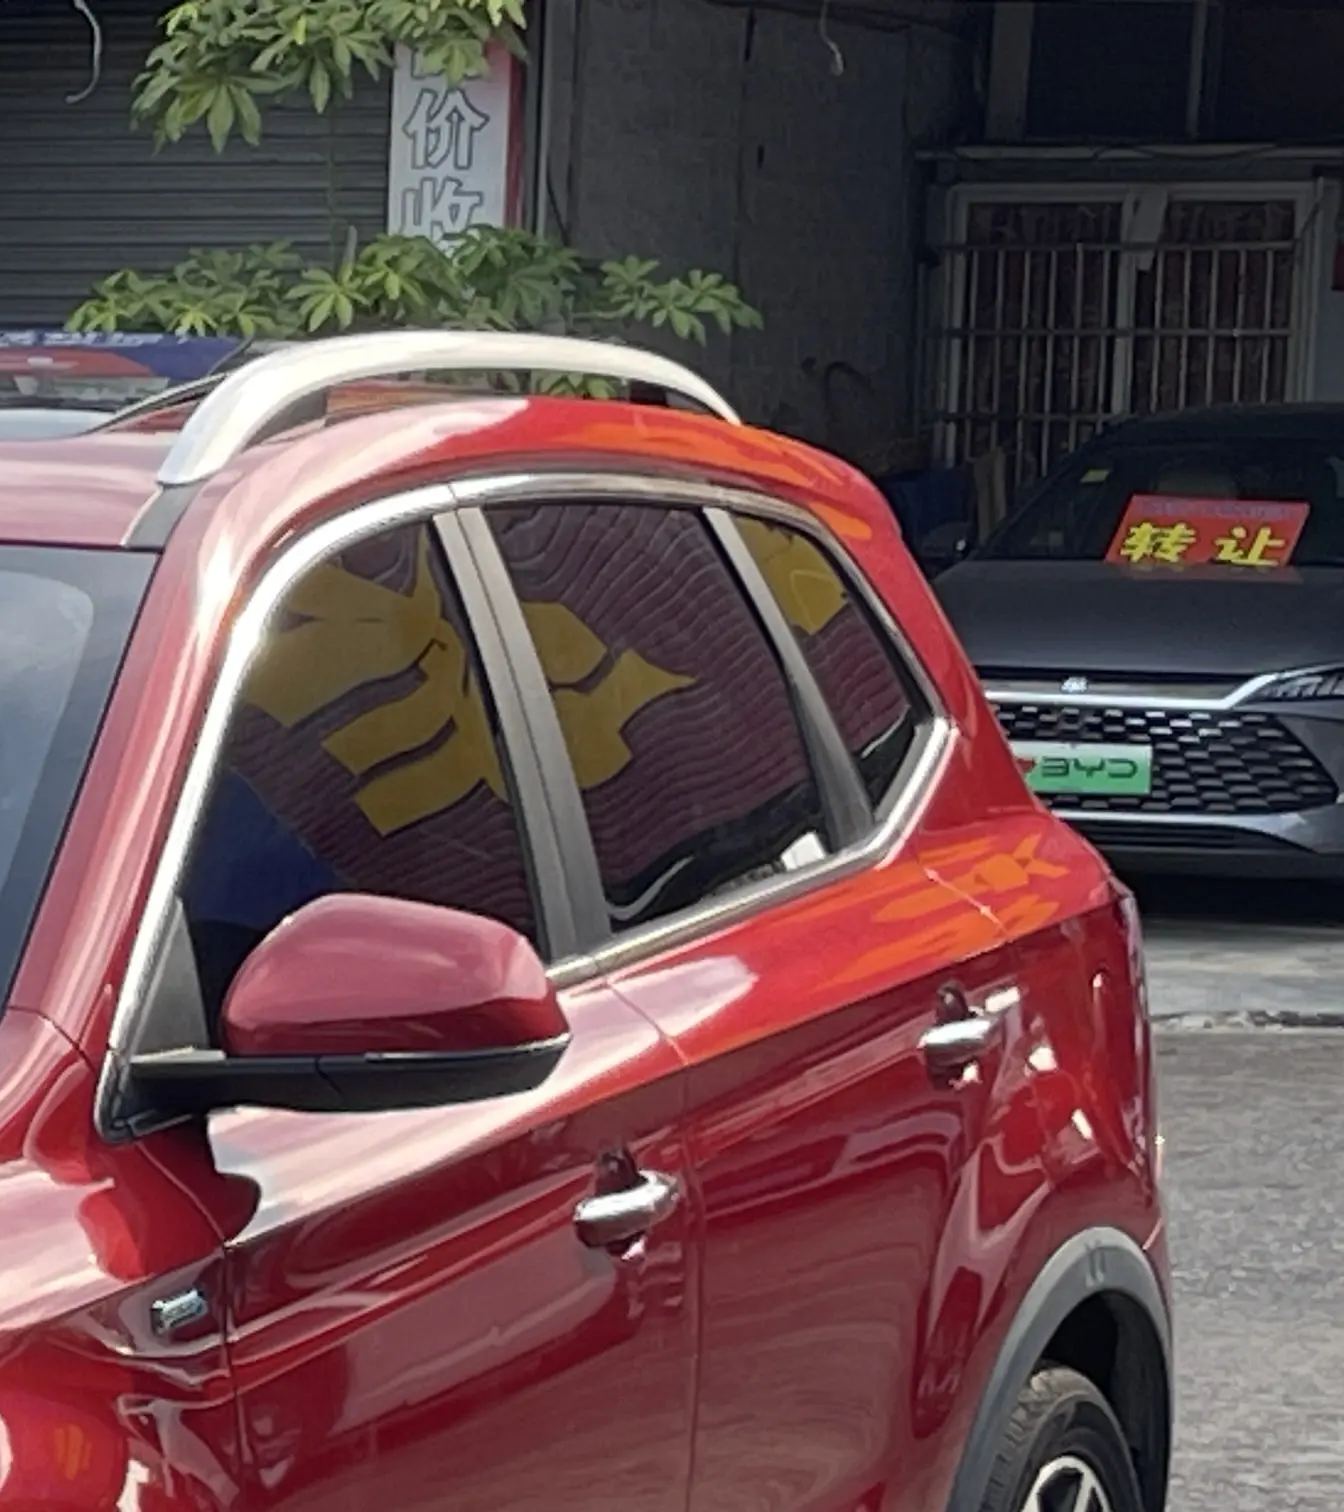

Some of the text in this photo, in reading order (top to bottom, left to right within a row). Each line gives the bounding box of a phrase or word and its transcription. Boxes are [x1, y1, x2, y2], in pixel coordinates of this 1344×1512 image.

[400, 48, 491, 252] 价收
[1120, 521, 1290, 566] 转让
[1041, 756, 1138, 779] BYD
